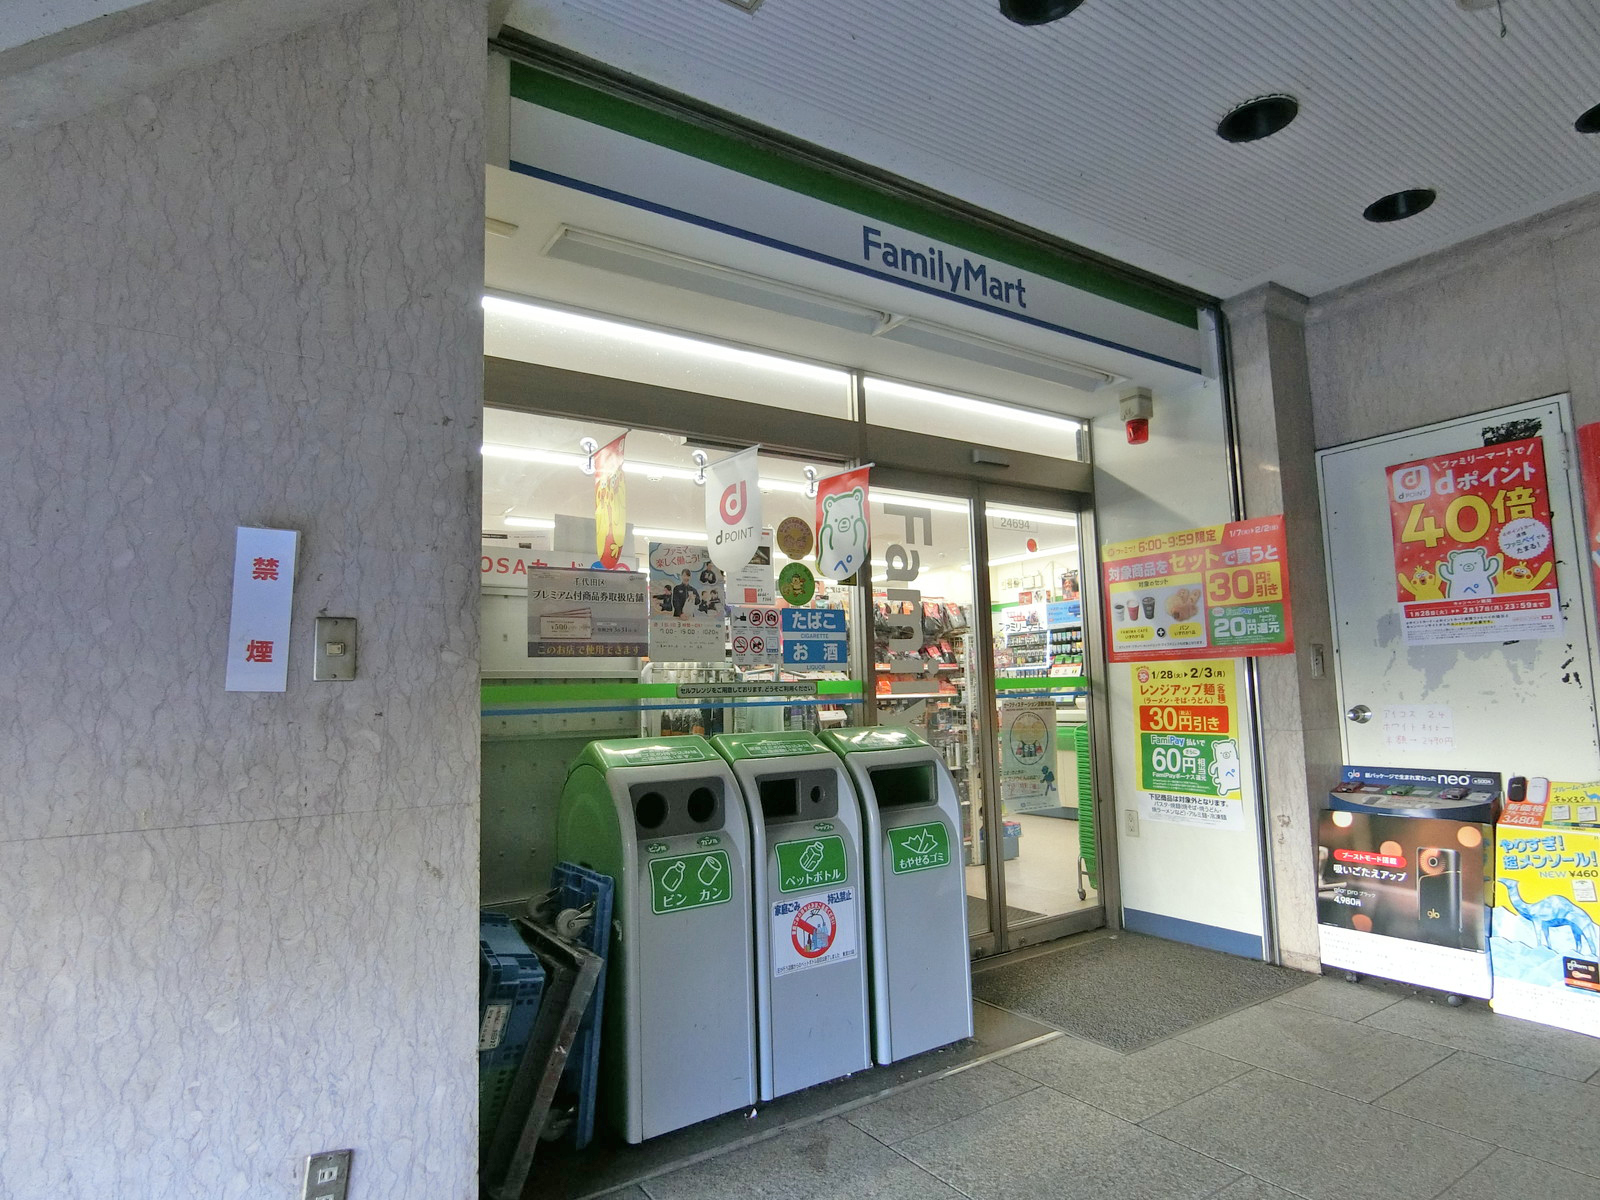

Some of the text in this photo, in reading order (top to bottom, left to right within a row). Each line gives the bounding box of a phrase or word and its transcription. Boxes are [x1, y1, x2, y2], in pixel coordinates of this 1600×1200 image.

[863, 225, 1027, 309] FamilyMart
[1441, 446, 1525, 469] ファミリーマートで
[1435, 461, 1536, 495] dポイント
[1000, 517, 1030, 530] 24694
[1401, 485, 1537, 548] 40倍
[724, 526, 754, 543] POINT
[656, 554, 701, 568] 楽しく働こう!
[1108, 545, 1279, 581] 対象商品をセットで買うと
[574, 578, 607, 587] 千代田区
[1209, 569, 1255, 602] 30
[1255, 571, 1266, 584] 円
[1256, 583, 1279, 598] 引き
[533, 589, 644, 603] プレミアム付商品券取扱店舗
[246, 557, 279, 663] 禁煙
[792, 611, 837, 630] たばこ
[537, 644, 640, 656] このお店で使用できます
[1190, 667, 1226, 679] 2/3(月)
[1140, 683, 1216, 696] レンジアップ麺
[1149, 706, 1220, 732] 30円引き
[1151, 735, 1185, 747] FamiPay
[1347, 769, 1361, 779] glo
[1438, 774, 1470, 786] neo
[1149, 793, 1229, 808] 下記商品は対象外となります。
[1507, 803, 1545, 812] 新価格
[1499, 835, 1565, 853] やりすぎ!
[899, 852, 944, 869] もやせるゴミ
[1342, 852, 1398, 865] ブーストモード搭載
[1503, 850, 1598, 870] 超メンソール!
[785, 869, 842, 886] ペットボトル
[1333, 864, 1407, 882] 吸いごたえアップ
[1569, 869, 1599, 878] ¥460
[663, 887, 723, 908] ビン カン
[827, 890, 853, 905] 持込禁止
[774, 901, 801, 917] 家庭ごみ
[1426, 908, 1440, 920] glo
